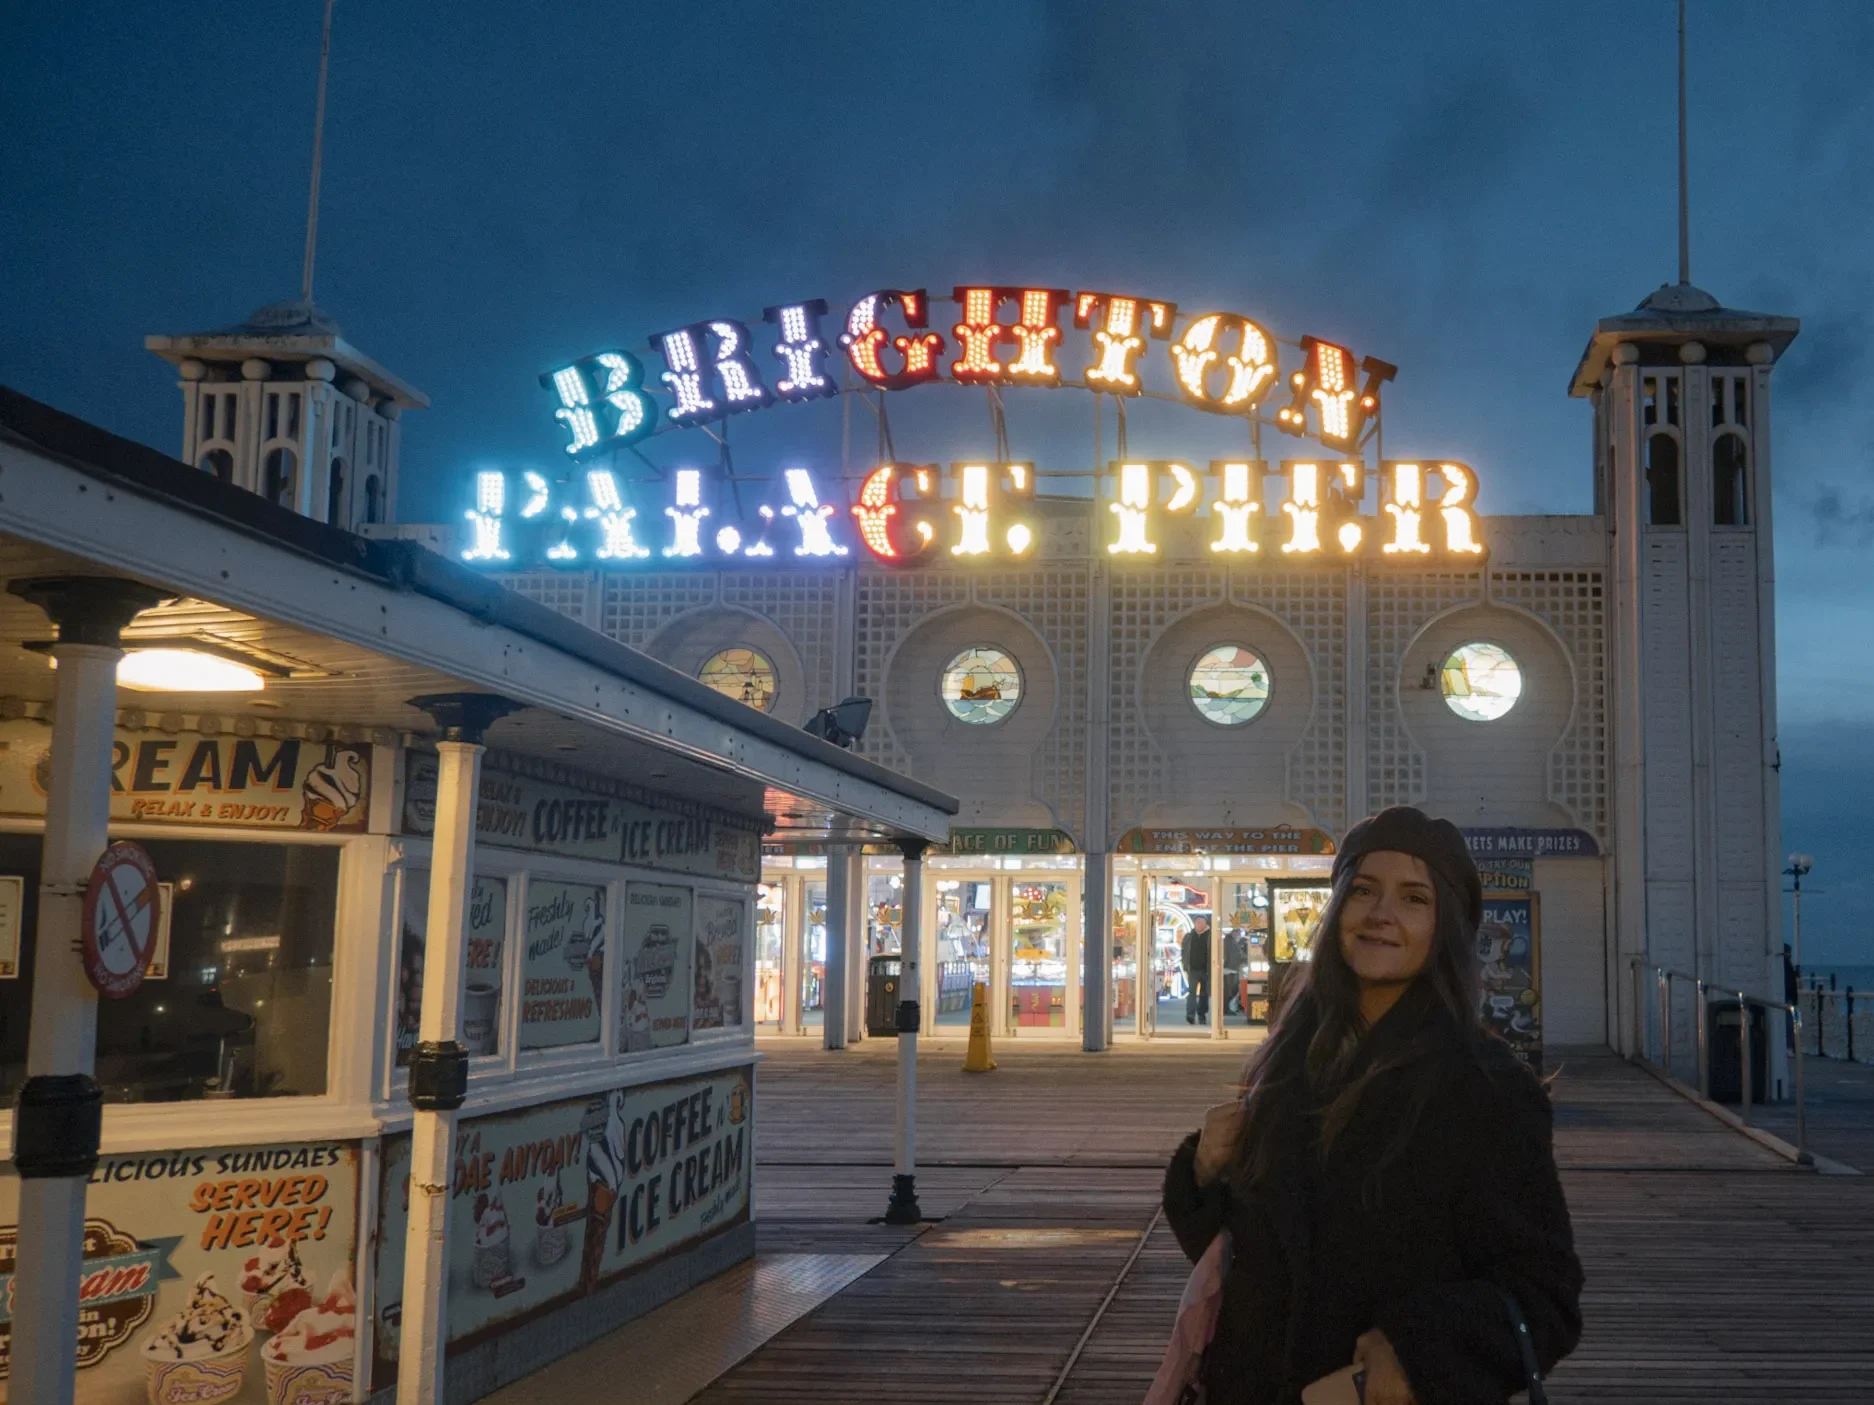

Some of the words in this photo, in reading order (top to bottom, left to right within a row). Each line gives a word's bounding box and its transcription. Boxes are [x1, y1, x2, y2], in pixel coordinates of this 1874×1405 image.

[540, 287, 1398, 462] BRIGHTON
[461, 461, 1035, 566] PALACE
[1108, 460, 1490, 565] PIER
[34, 739, 300, 796] REAM
[132, 798, 195, 817] RELAX
[200, 803, 213, 817] &
[218, 803, 290, 822] ENJOY!
[533, 798, 611, 844] COFFEE
[619, 819, 652, 862] ICE
[656, 814, 711, 858] CREAM
[994, 834, 1017, 850] OF
[1027, 834, 1065, 850] FUN
[1152, 831, 1188, 840] THIS
[1195, 831, 1234, 840] WAY
[1243, 831, 1265, 840] TO
[1272, 831, 1302, 840] THE
[1156, 843, 1189, 853] END
[1197, 843, 1220, 853] OF
[1223, 843, 1256, 853] THE
[1260, 843, 1299, 853] PIER
[1464, 836, 1493, 851] KETS
[1498, 836, 1533, 851] MAKE
[1537, 835, 1580, 851] PRIZES
[1488, 859, 1507, 870] TRY
[1509, 859, 1531, 871] OUR
[527, 889, 574, 932] Freshly
[1483, 908, 1528, 925] PLAY!
[522, 996, 593, 1024] REFRESHING
[627, 1085, 713, 1177] COFFEE
[87, 1154, 206, 1184] LICIOUS
[215, 1145, 341, 1174] SUNDAES
[453, 1150, 496, 1199] DAE
[498, 1130, 583, 1184] ANYDAY!
[189, 1174, 329, 1214] SERVED
[615, 1173, 662, 1255] ICE
[668, 1127, 744, 1220] CREAM
[200, 1206, 333, 1250] HERE!
